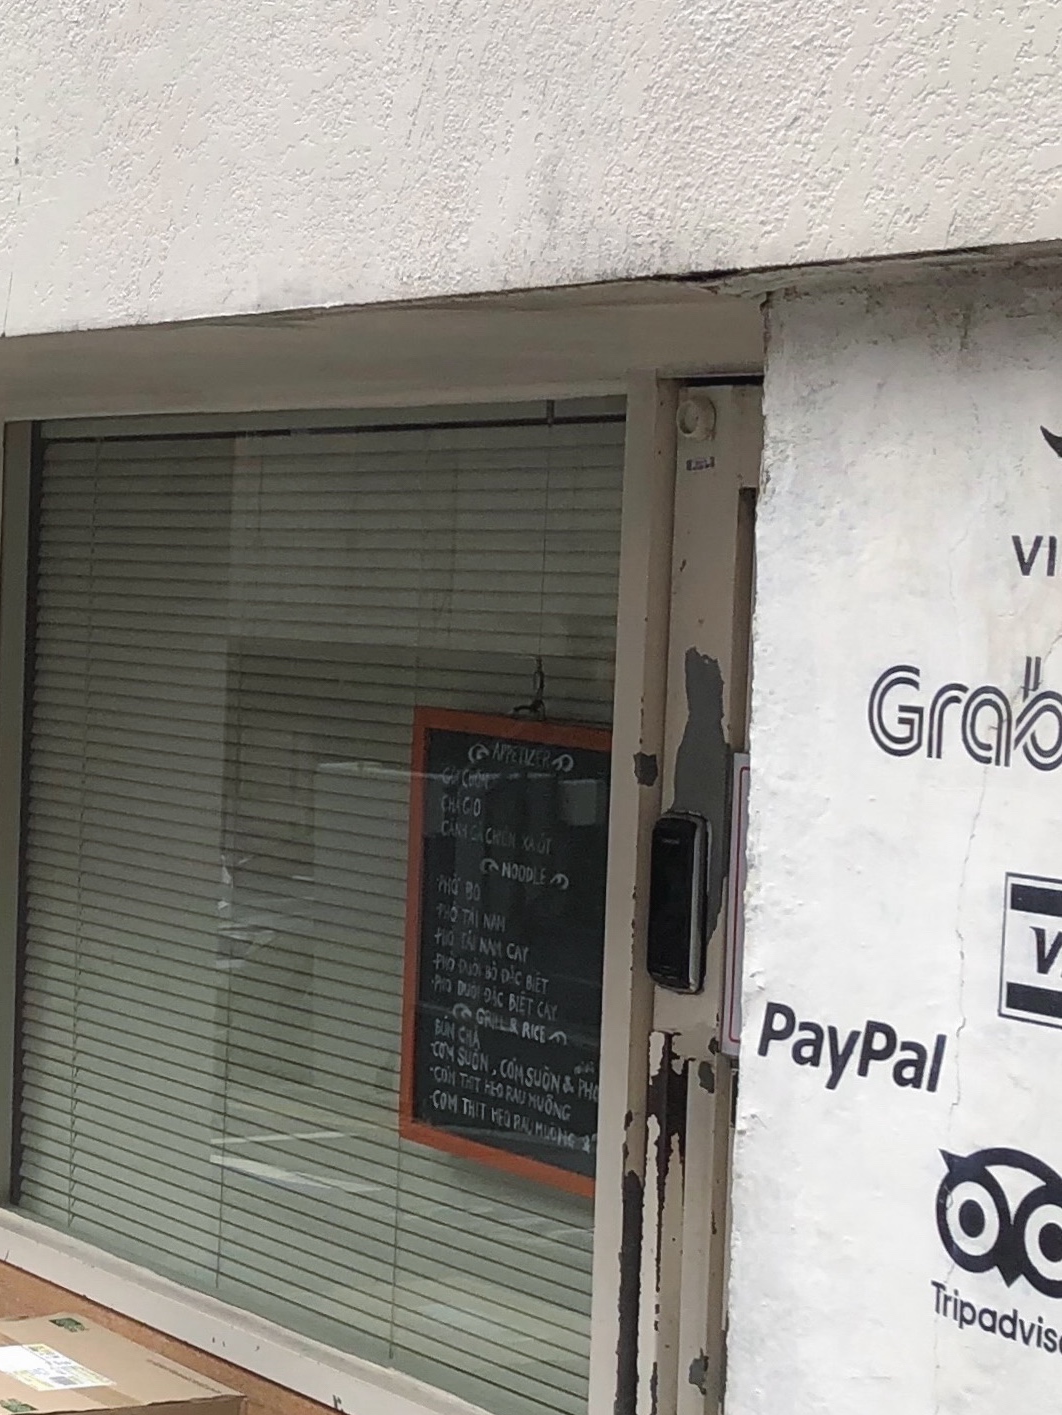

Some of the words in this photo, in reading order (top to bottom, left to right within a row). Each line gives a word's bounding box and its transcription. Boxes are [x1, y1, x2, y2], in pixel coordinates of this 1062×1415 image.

[867, 655, 1062, 771] Grab
[501, 862, 548, 886] NOODLE
[521, 1021, 546, 1043] RICE
[758, 1001, 947, 1093] PayPal
[563, 1075, 575, 1094] &
[931, 1280, 1062, 1356] Tripadvis
